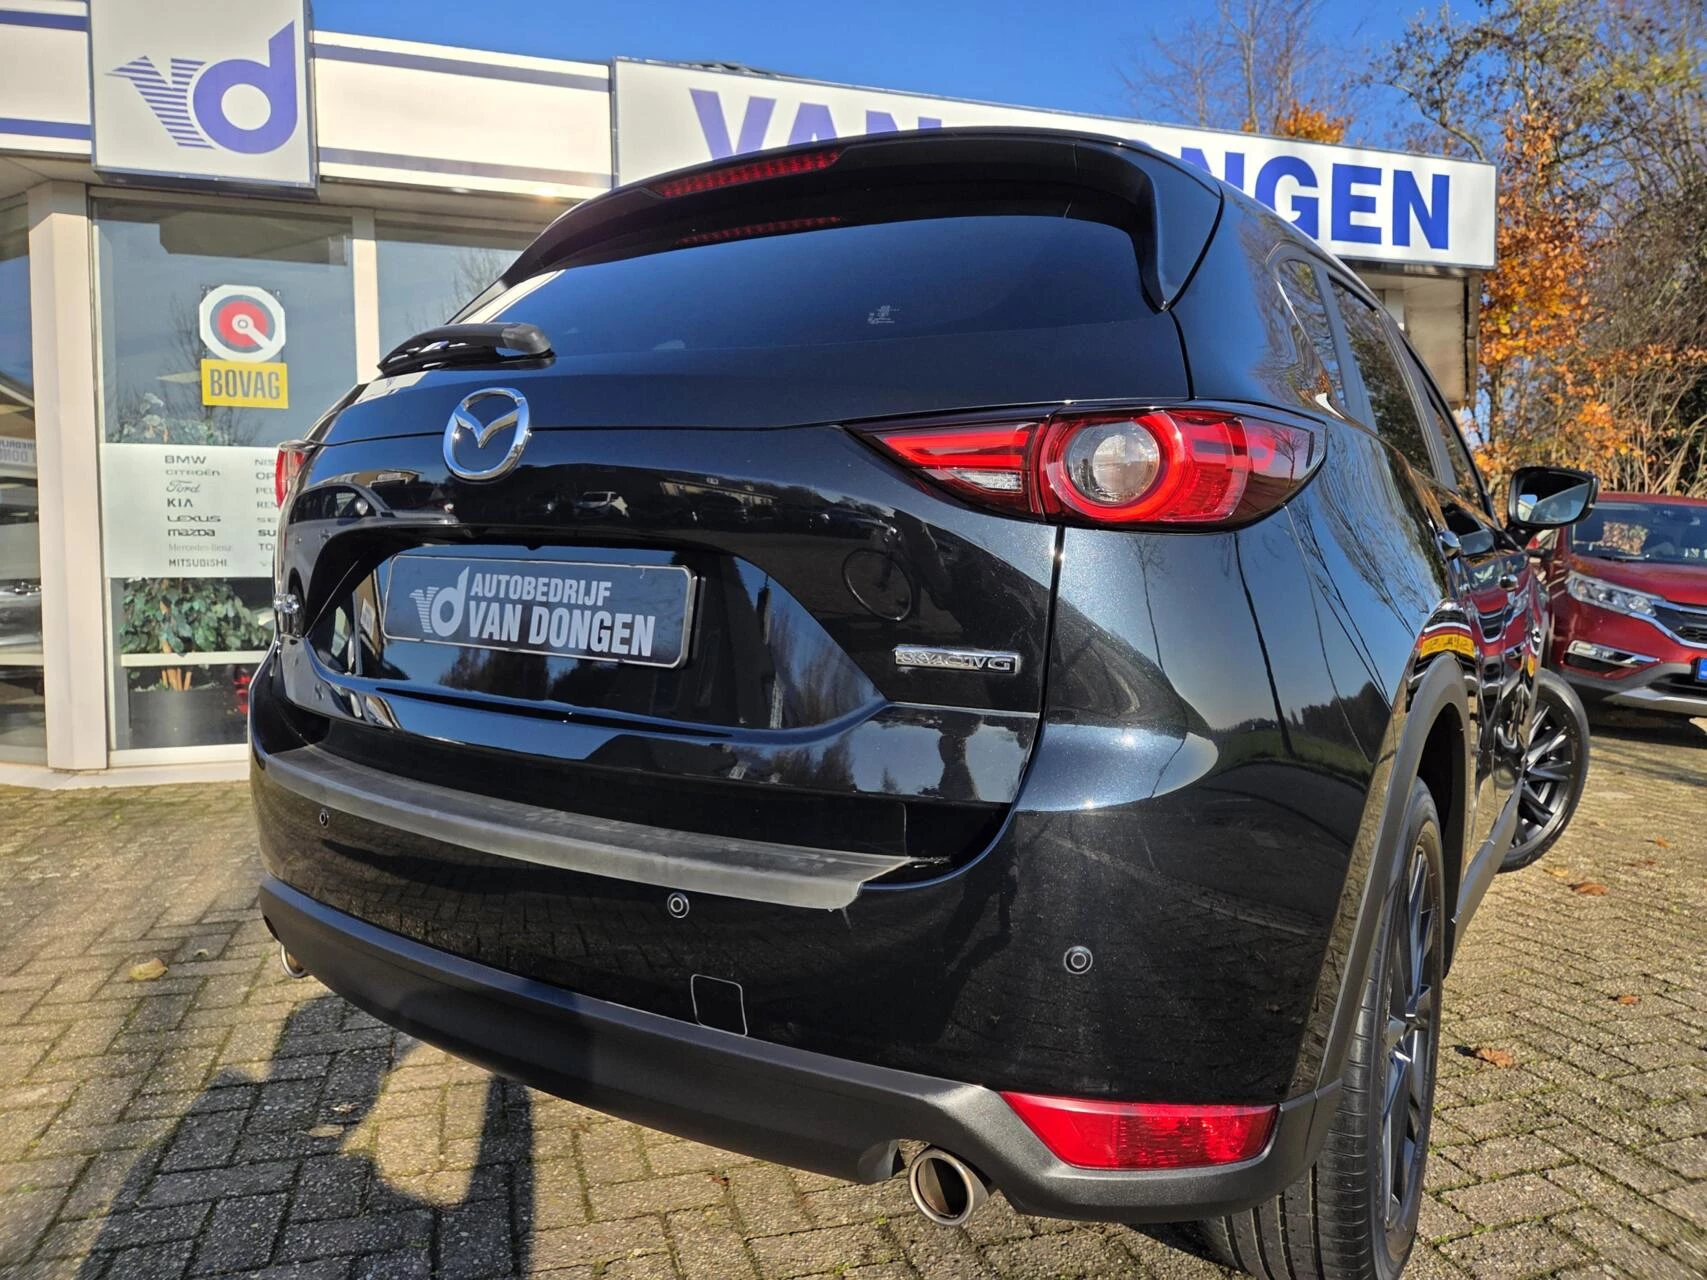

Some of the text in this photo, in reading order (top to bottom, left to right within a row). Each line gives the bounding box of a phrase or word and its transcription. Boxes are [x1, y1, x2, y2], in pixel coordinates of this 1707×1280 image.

[210, 368, 280, 399] BOVAG
[165, 455, 206, 464] BMW
[255, 472, 275, 480] OP
[166, 479, 201, 493] Ford
[167, 498, 194, 508] KIA
[167, 515, 221, 523] LEXUS
[258, 529, 277, 537] SU
[168, 558, 228, 568] MITSUBISHI
[470, 573, 612, 606] AUTOBEDRIJF
[469, 601, 656, 657] VAN DONGEN
